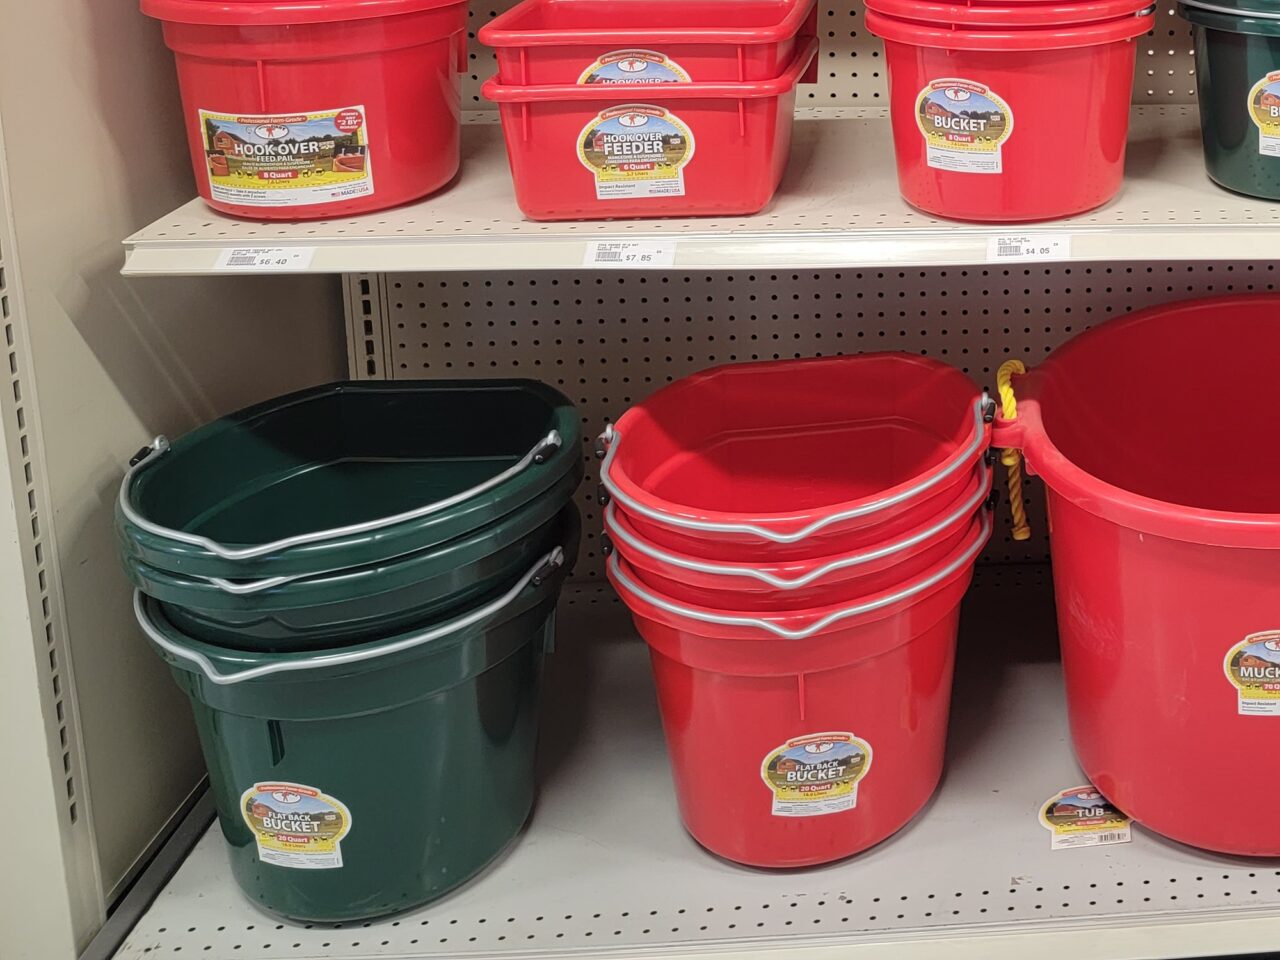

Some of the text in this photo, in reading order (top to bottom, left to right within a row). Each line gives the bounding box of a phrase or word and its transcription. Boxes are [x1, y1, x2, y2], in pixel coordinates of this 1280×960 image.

[934, 116, 986, 131] BUCKET
[603, 132, 663, 142] HOOK OVER
[234, 141, 320, 156] HOOK OVER
[604, 141, 663, 155] FEEDER
[625, 254, 652, 262] $7.85
[816, 761, 839, 770] BACK
[787, 766, 846, 782] BUCKET
[269, 811, 287, 820] FLAT
[1078, 808, 1105, 817] TUB
[262, 817, 321, 832] BUCKET
